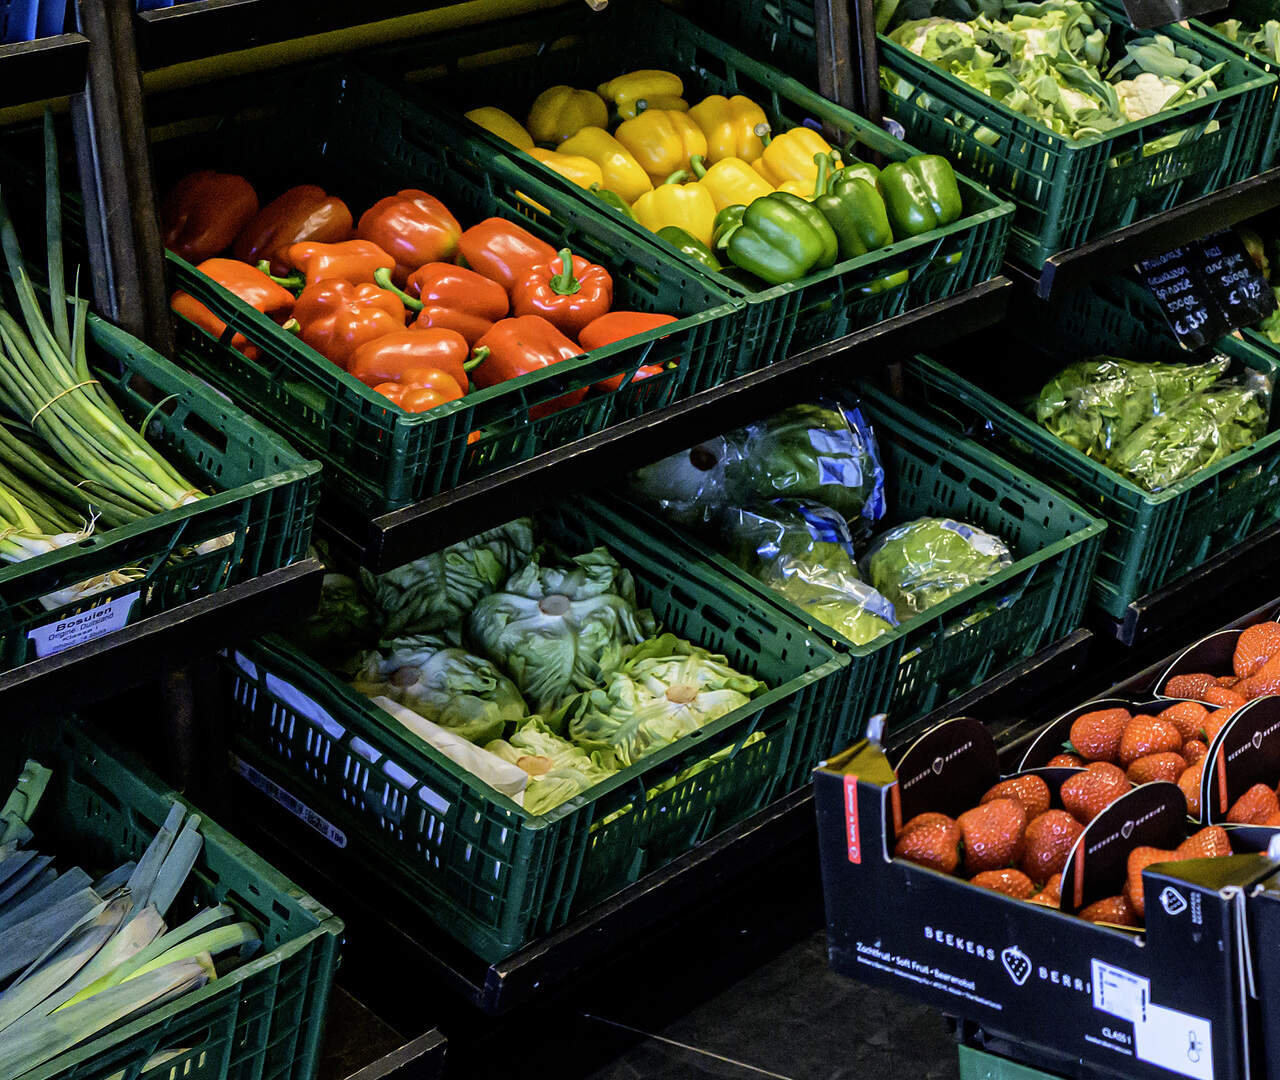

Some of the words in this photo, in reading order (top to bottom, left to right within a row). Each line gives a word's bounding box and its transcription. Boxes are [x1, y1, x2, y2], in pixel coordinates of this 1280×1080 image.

[56, 607, 112, 632] Bosuien
[924, 926, 996, 961] BEEKERS
[1038, 966, 1092, 995] BERRI
